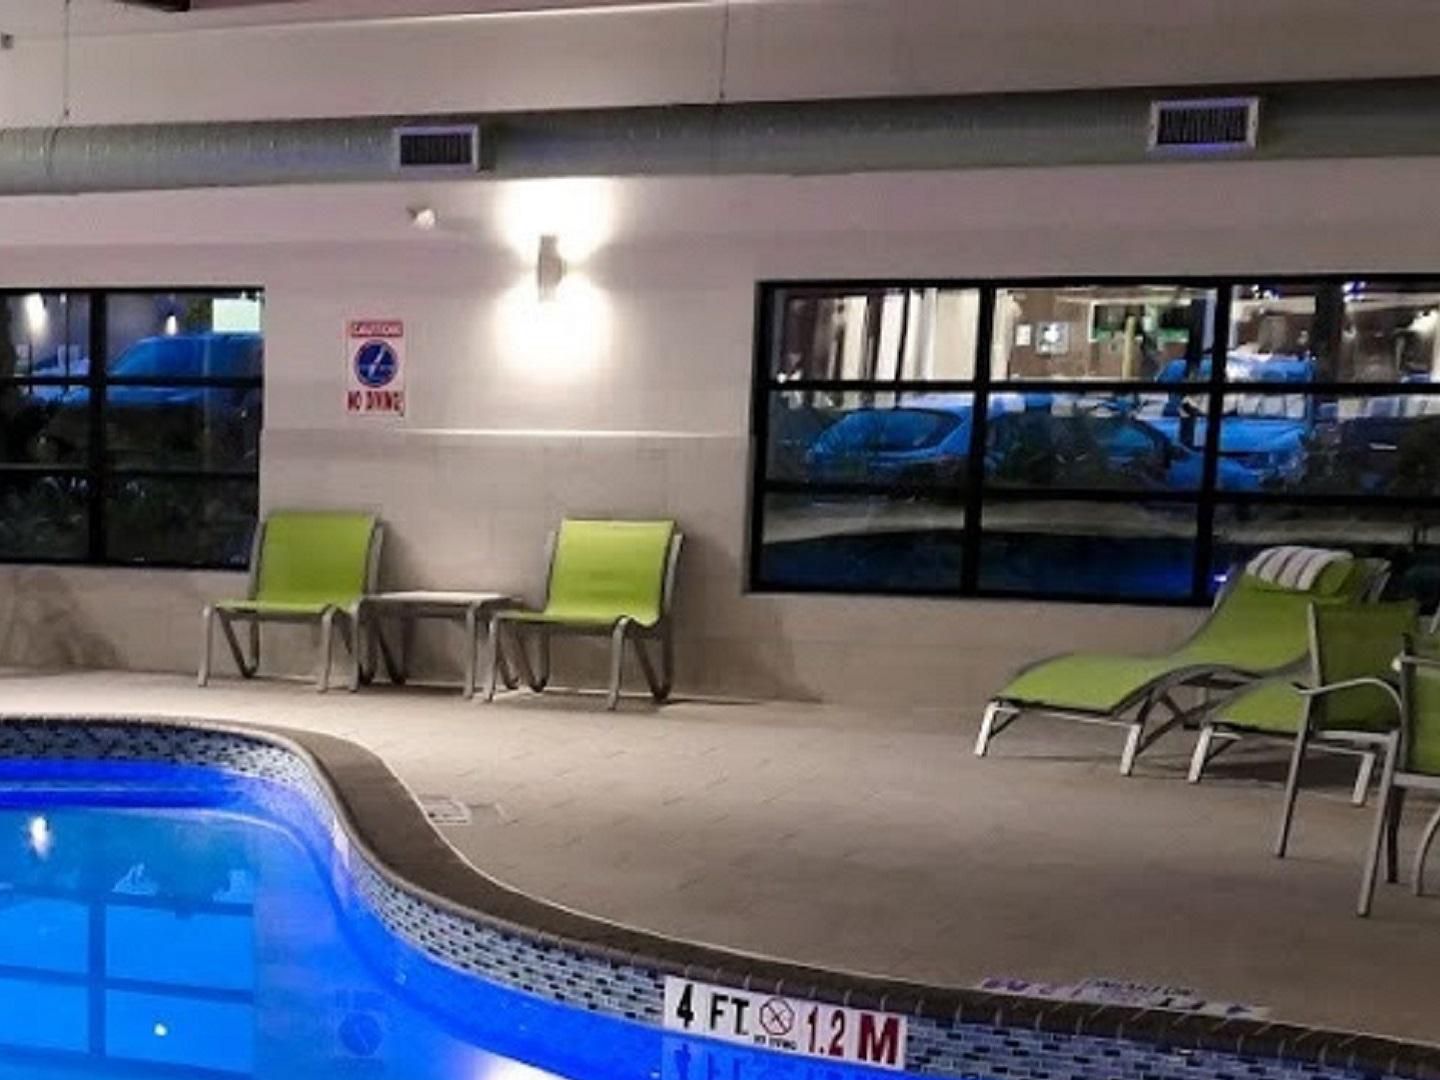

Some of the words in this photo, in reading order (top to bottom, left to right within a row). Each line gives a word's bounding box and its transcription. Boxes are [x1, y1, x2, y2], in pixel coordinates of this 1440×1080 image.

[677, 983, 695, 1029] 4
[808, 1005, 845, 1057] 1.2
[858, 1013, 901, 1066] M
